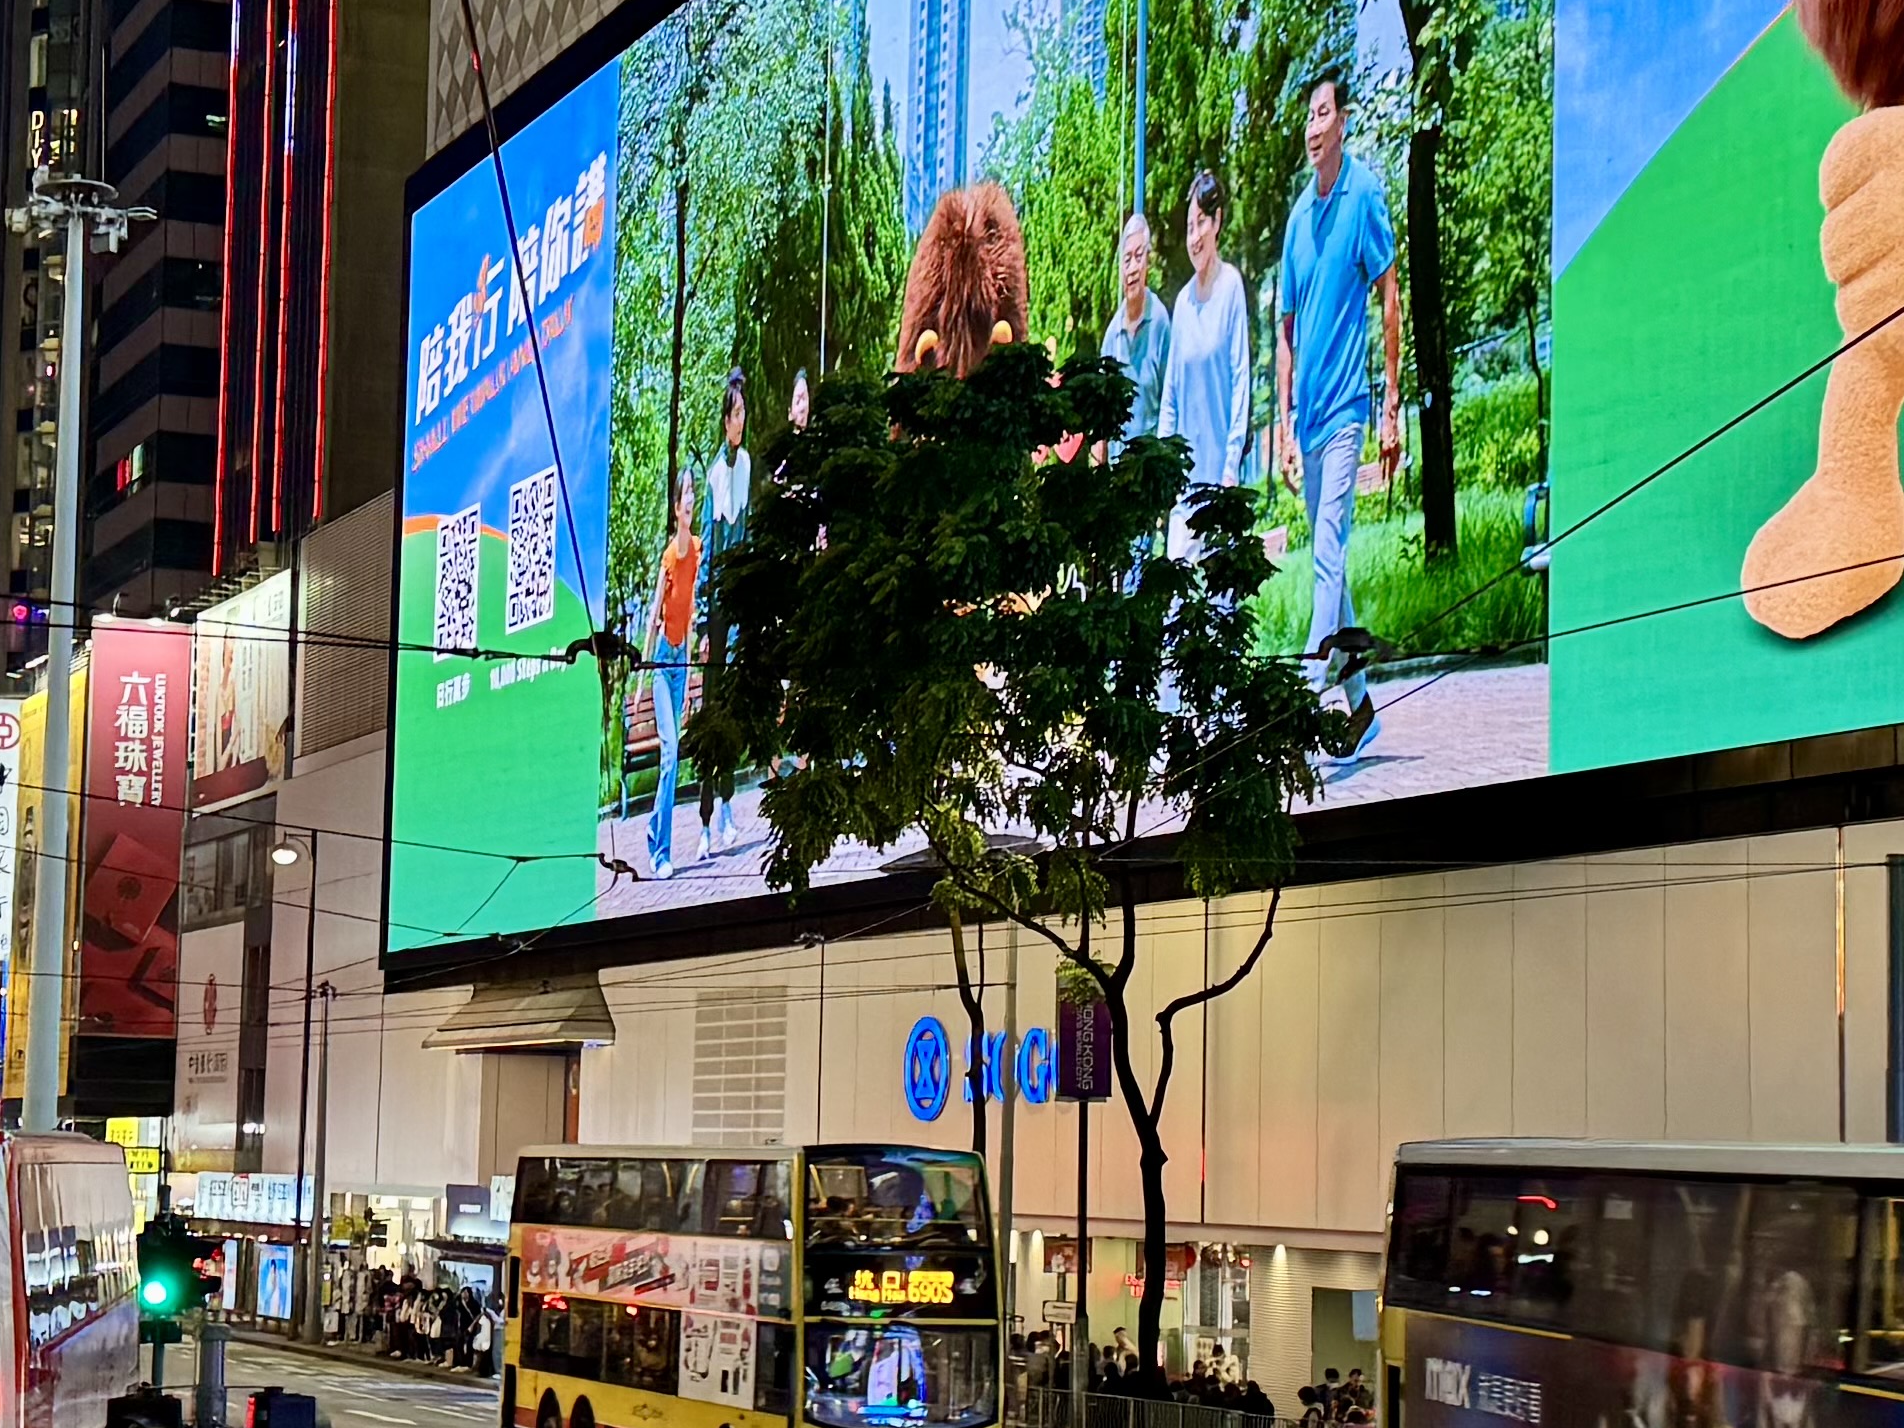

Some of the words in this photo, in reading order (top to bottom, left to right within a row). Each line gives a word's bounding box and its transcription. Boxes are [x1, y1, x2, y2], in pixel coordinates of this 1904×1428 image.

[114, 671, 152, 808] 六福珠寶
[1082, 1044, 1094, 1090] KONG
